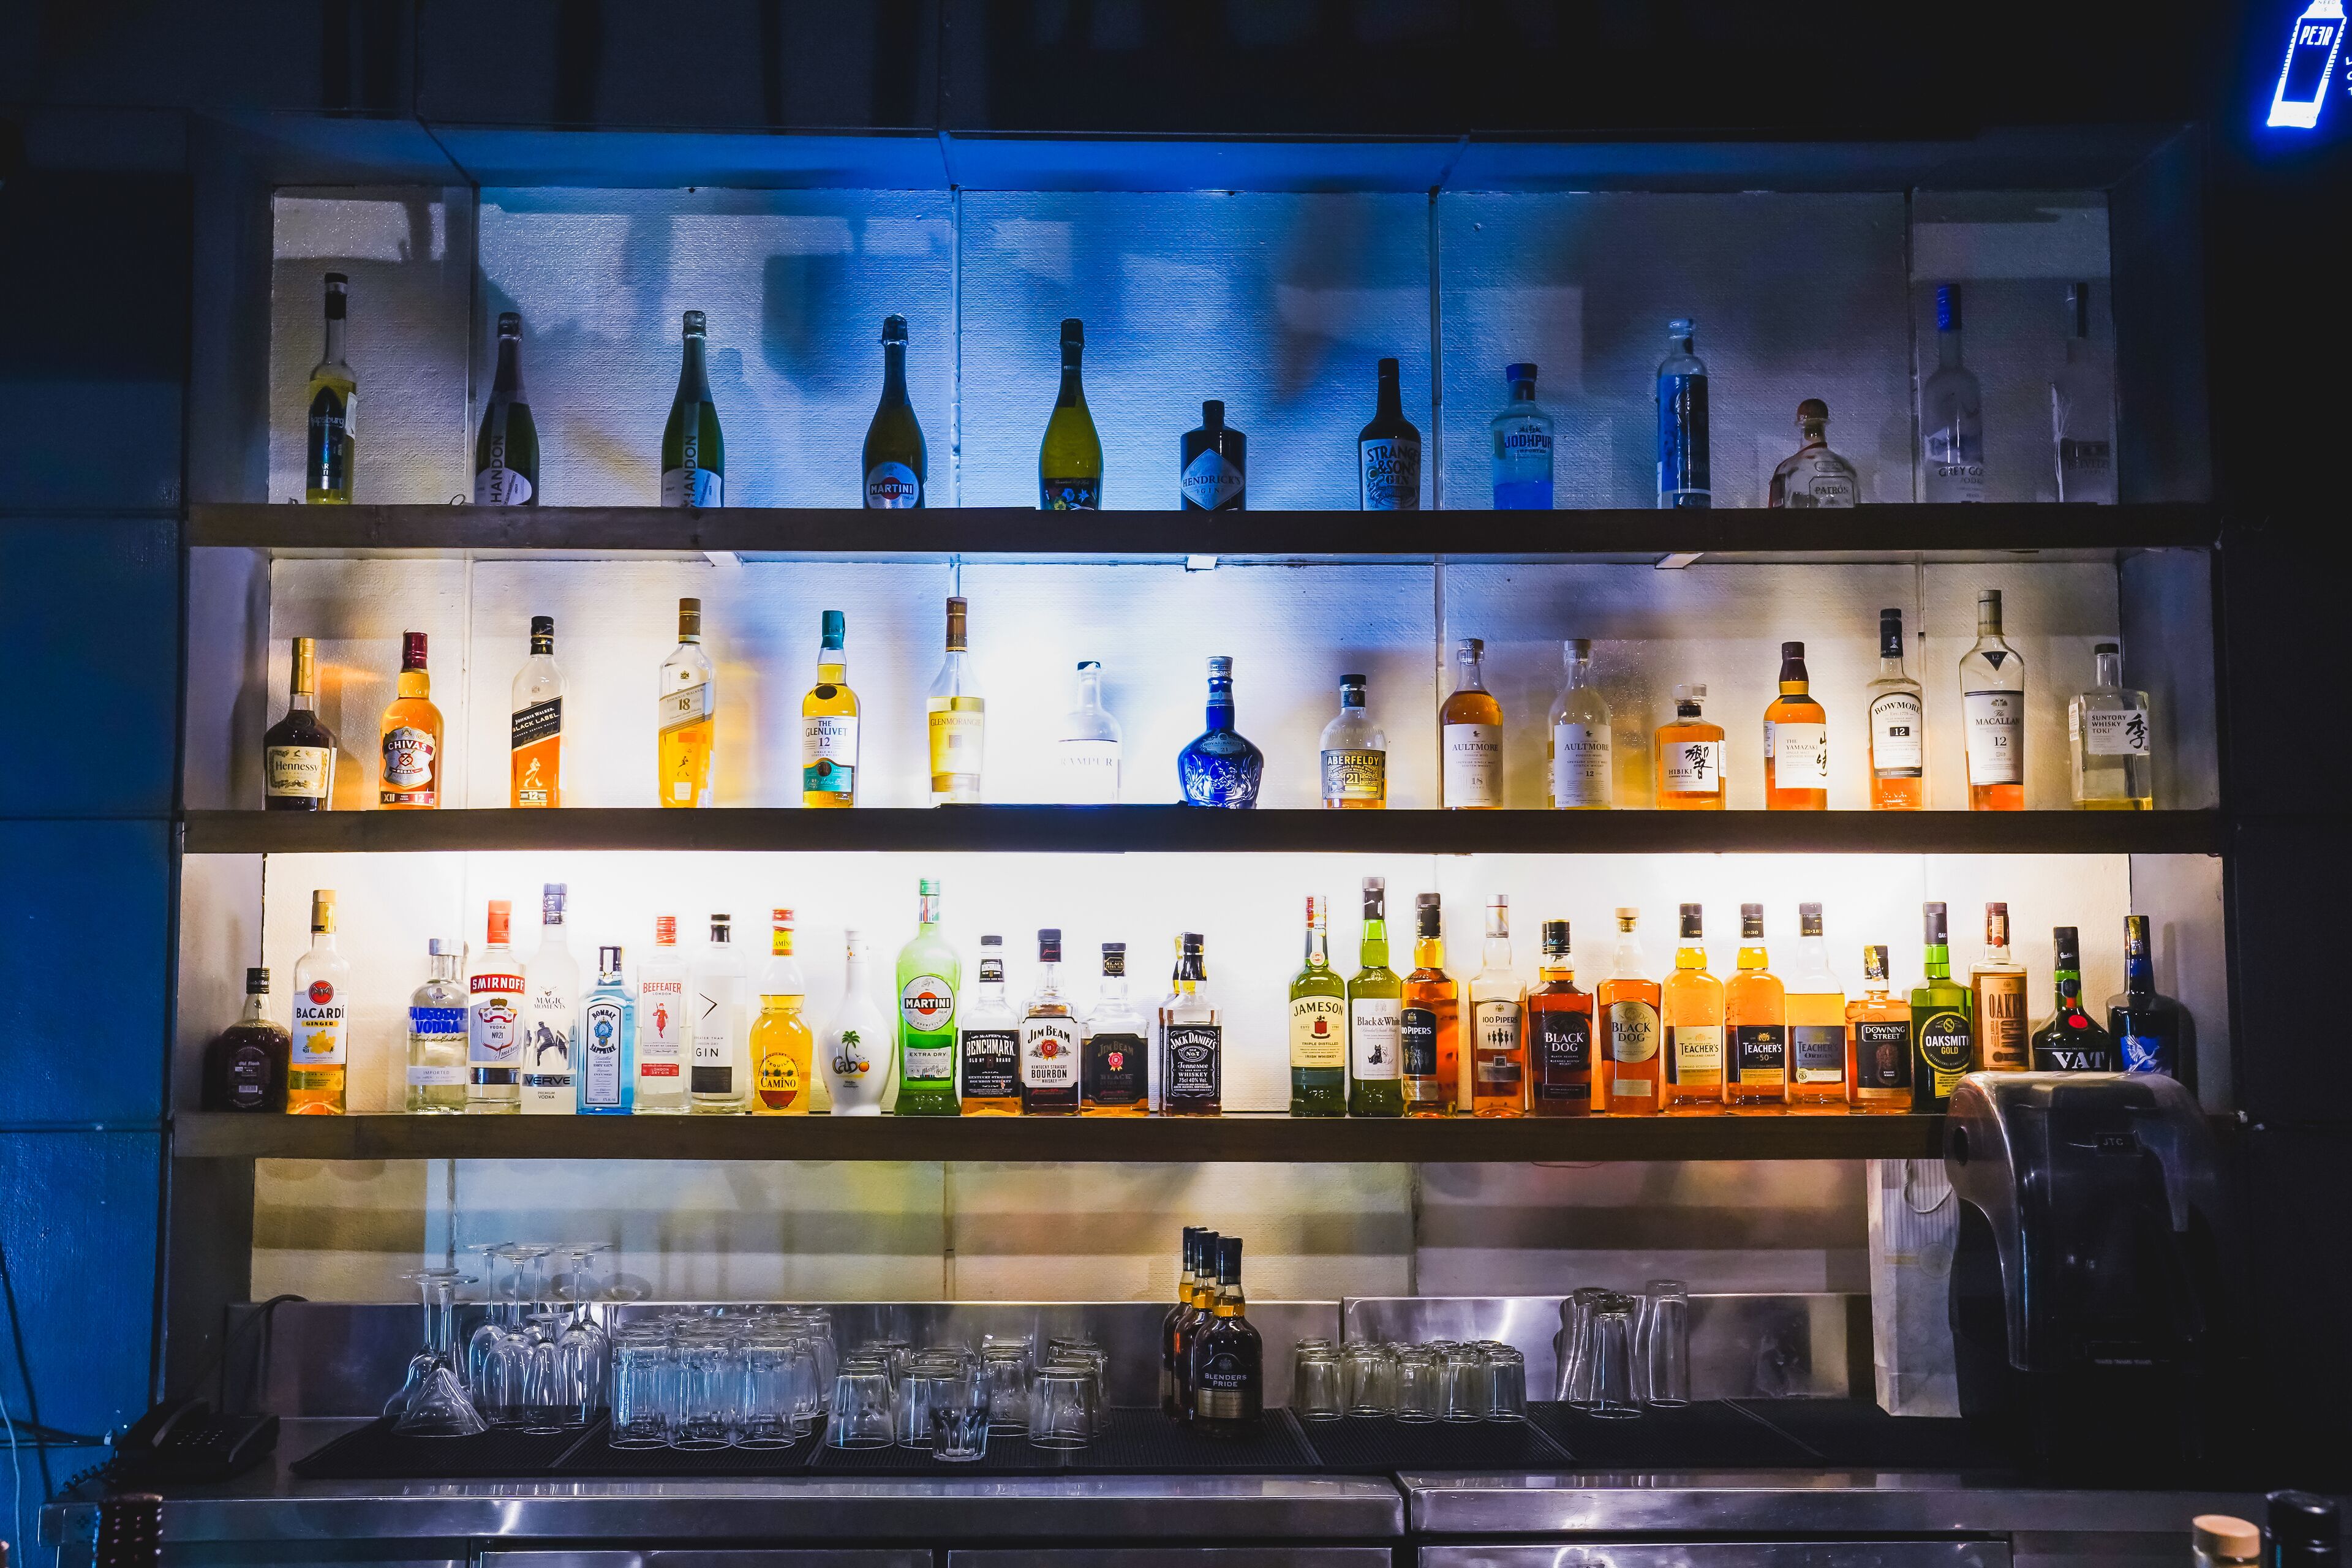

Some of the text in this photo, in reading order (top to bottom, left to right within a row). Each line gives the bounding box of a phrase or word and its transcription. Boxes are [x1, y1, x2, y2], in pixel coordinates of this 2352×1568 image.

[1504, 434, 1551, 449] JODHPUR
[491, 435, 503, 503] HANDON
[684, 435, 696, 505] HANDON
[1183, 475, 1241, 488] HENDRICK'S
[1385, 475, 1409, 485] GIN
[870, 484, 913, 494] MARTINI
[679, 698, 690, 710] 18
[1874, 701, 1920, 715] BOWMORE
[515, 714, 535, 725] JOHNNIE
[930, 717, 982, 726] GLENMORANGIE
[512, 721, 534, 733] BLACK
[805, 727, 848, 737] GLENLIVET
[388, 740, 427, 752] CHIVAS
[818, 737, 831, 747] 12
[1994, 736, 2007, 746] 12
[1060, 757, 1113, 766] RAMPUR
[1327, 756, 1379, 765] ABERFELDY
[275, 761, 319, 772] Hennessy
[1346, 773, 1359, 784] 21
[529, 791, 538, 800] 12
[472, 976, 524, 990] SMIRNOFF
[643, 982, 682, 994] BEEFEATER
[906, 998, 949, 1009] MARTINI
[1294, 1001, 1344, 1017] JAMESON
[296, 1005, 345, 1019] BACARDÍ
[412, 1008, 464, 1020] ABSOLUT
[591, 1009, 617, 1020] BOMBAY
[415, 1020, 459, 1033] VODKA
[1611, 1022, 1651, 1033] BLACK
[1028, 1025, 1071, 1044] JIM BEAM
[1545, 1032, 1584, 1042] BLACK
[1618, 1033, 1645, 1042] DOG
[1170, 1032, 1217, 1050] JACK DANIEL'S
[589, 1043, 617, 1054] SAPPHIRE
[696, 1047, 718, 1057] GIN
[966, 1039, 1015, 1057] BENCHMARK
[1098, 1041, 1134, 1057] JIM BEAM
[1551, 1043, 1578, 1052] DOG
[1679, 1042, 1719, 1055] TEACHER'S
[1743, 1042, 1782, 1055] TEACHER'S
[1797, 1041, 1838, 1054] TEACHER'S
[832, 1055, 870, 1074] Cabo
[2052, 1051, 2105, 1069] VAT
[1031, 1069, 1067, 1078] BOURBON
[525, 1076, 570, 1085] VERVE
[2103, 1137, 2124, 1146] JTC
[1204, 1373, 1247, 1381] BLENDERS
